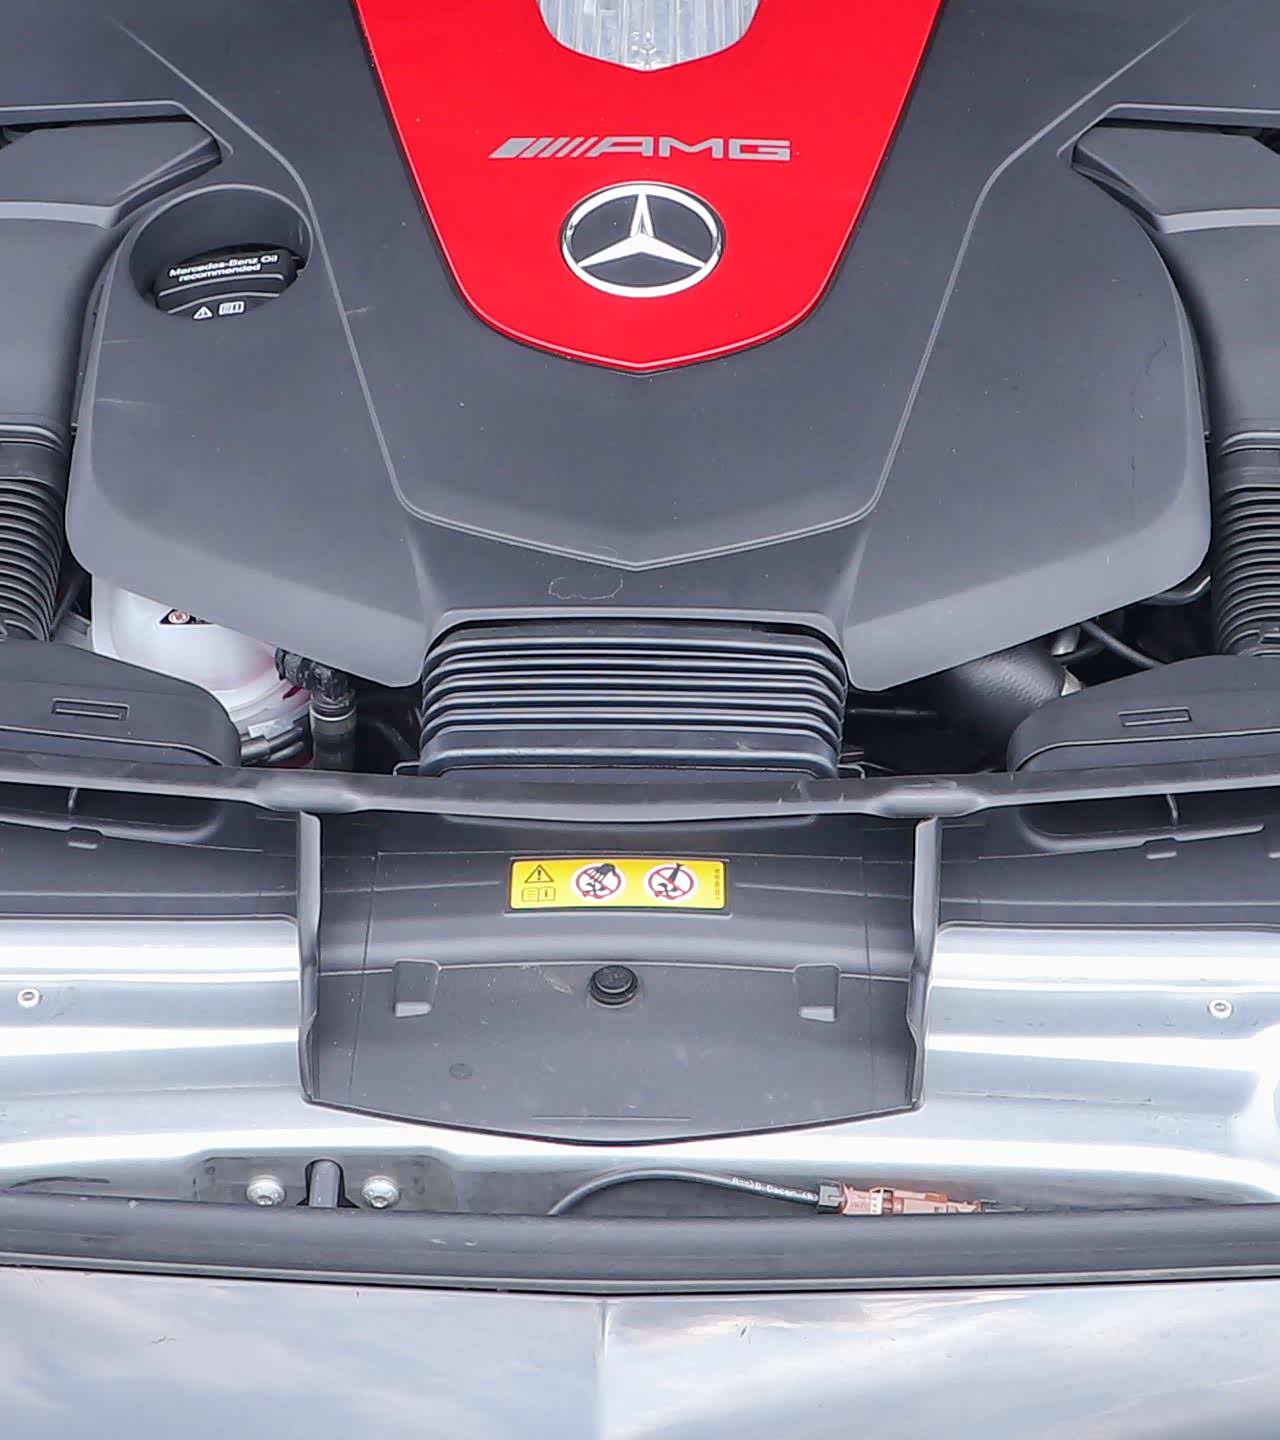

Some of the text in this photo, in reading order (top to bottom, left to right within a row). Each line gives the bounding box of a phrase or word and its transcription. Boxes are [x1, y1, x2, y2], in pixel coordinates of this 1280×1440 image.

[168, 254, 278, 278] Mercedes-Benz Oil
[178, 263, 261, 282] recommended
